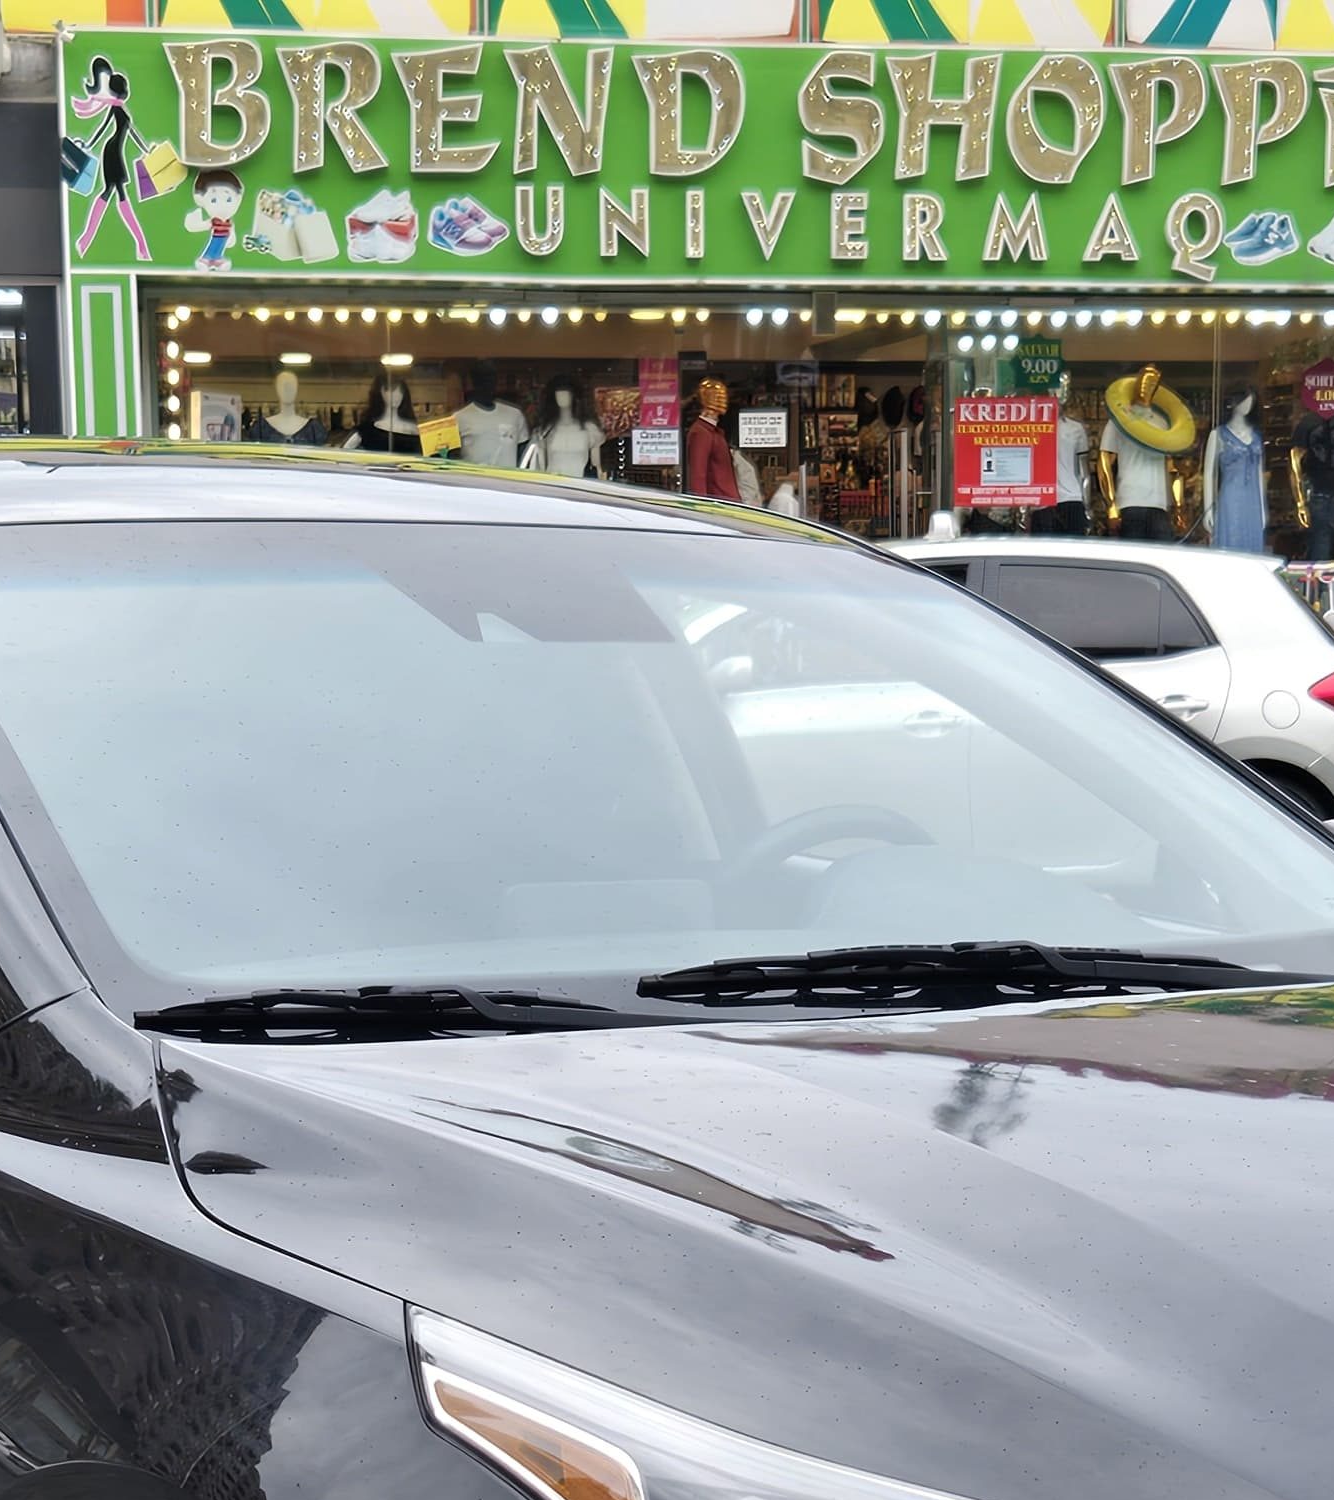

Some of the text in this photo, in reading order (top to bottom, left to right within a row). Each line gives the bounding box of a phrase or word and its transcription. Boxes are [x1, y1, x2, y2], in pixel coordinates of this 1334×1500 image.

[162, 39, 745, 178] BREND
[514, 184, 1227, 281] UNIVERMAQ
[1021, 359, 1058, 374] 9.00
[959, 399, 1053, 422] KREDİT
